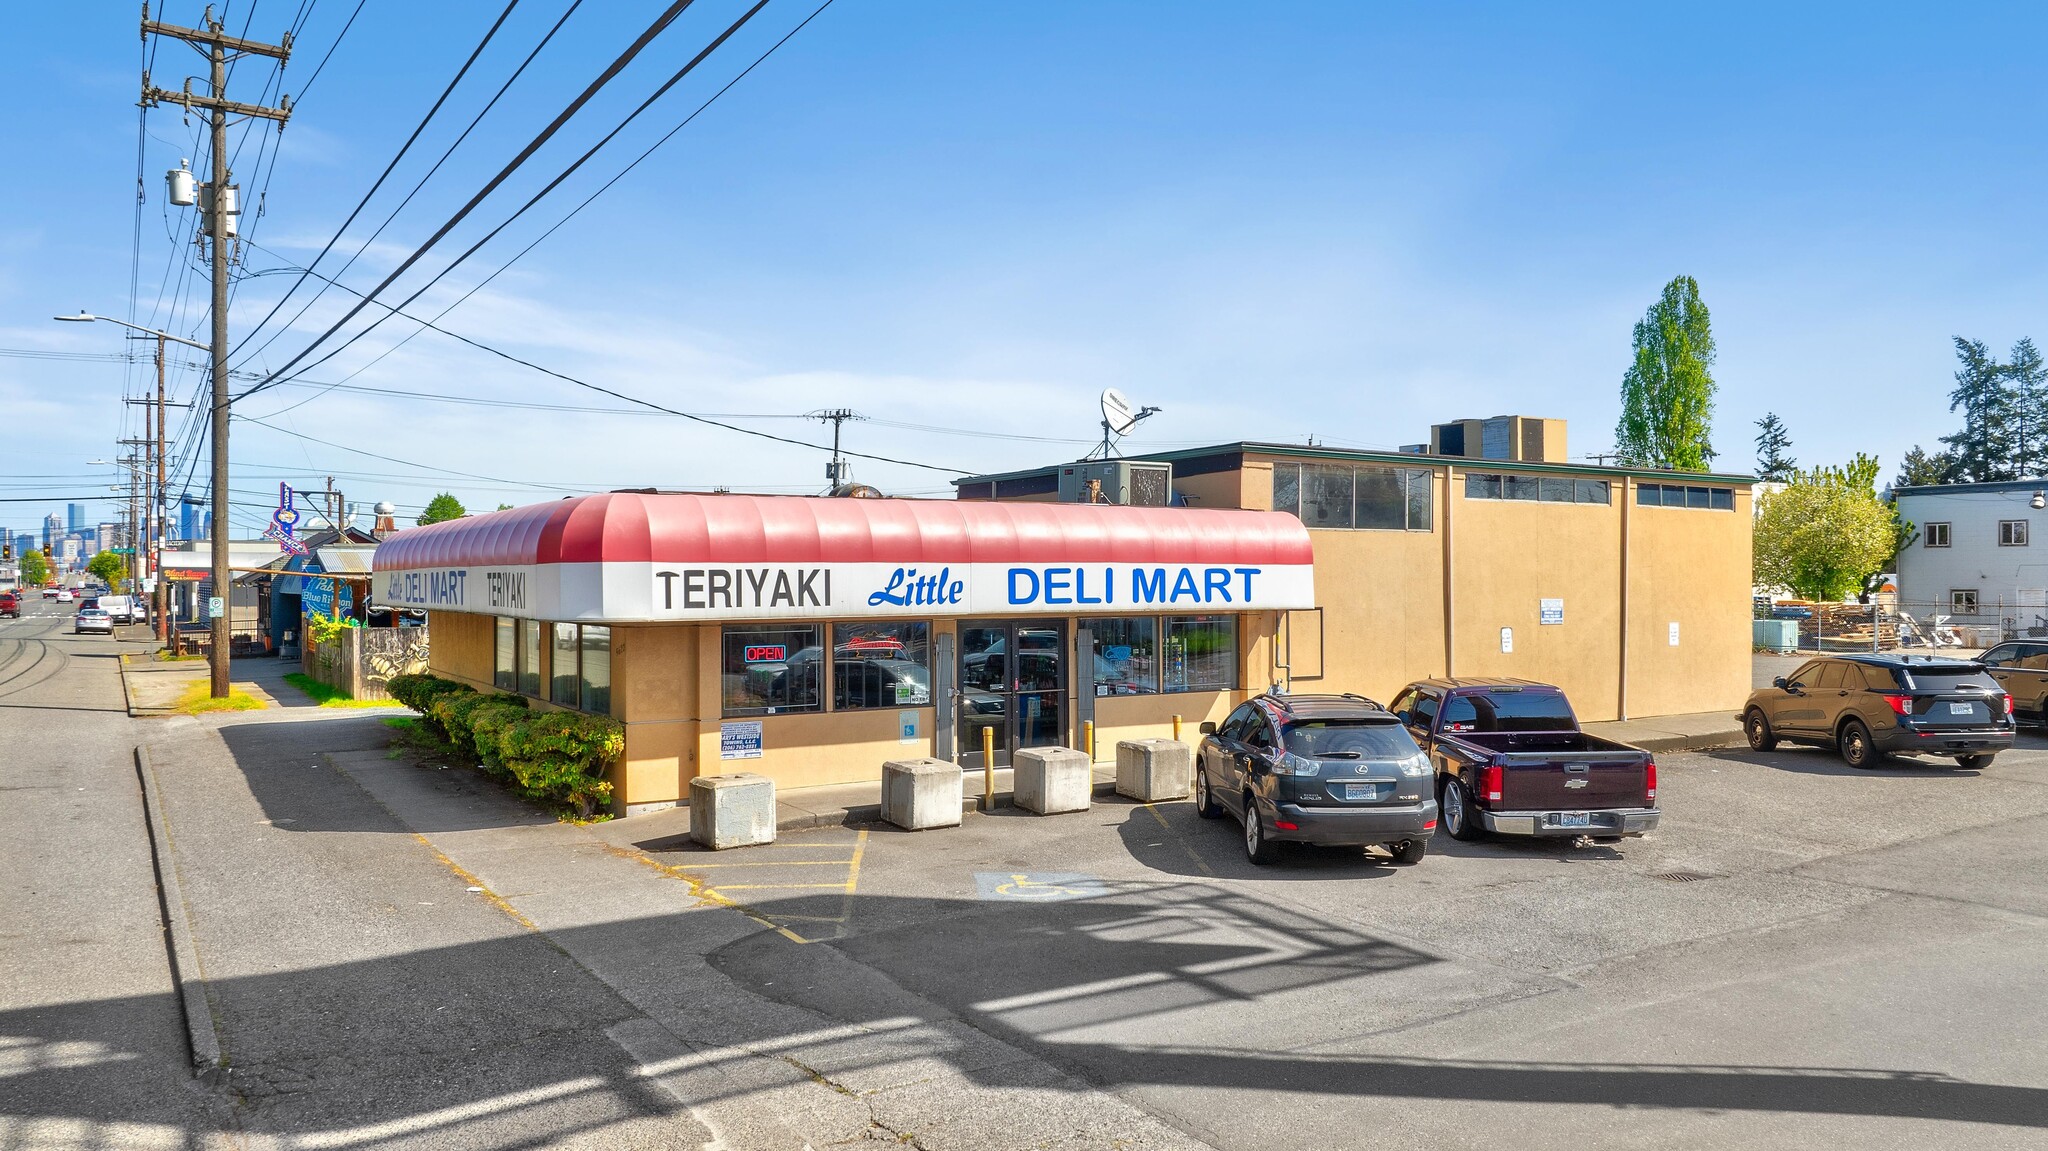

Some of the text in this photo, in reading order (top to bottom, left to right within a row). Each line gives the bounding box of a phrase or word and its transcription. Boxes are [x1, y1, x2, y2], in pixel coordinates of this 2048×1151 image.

[273, 531, 302, 552] CHANCE
[315, 578, 342, 593] Pab
[405, 573, 427, 603] DELI
[430, 570, 466, 605] MART
[487, 572, 526, 609] TERIYAKI
[656, 567, 1262, 610] TERIYAKI Little DELI MART
[303, 591, 351, 607] Blue Rion
[746, 647, 784, 661] OPEN
